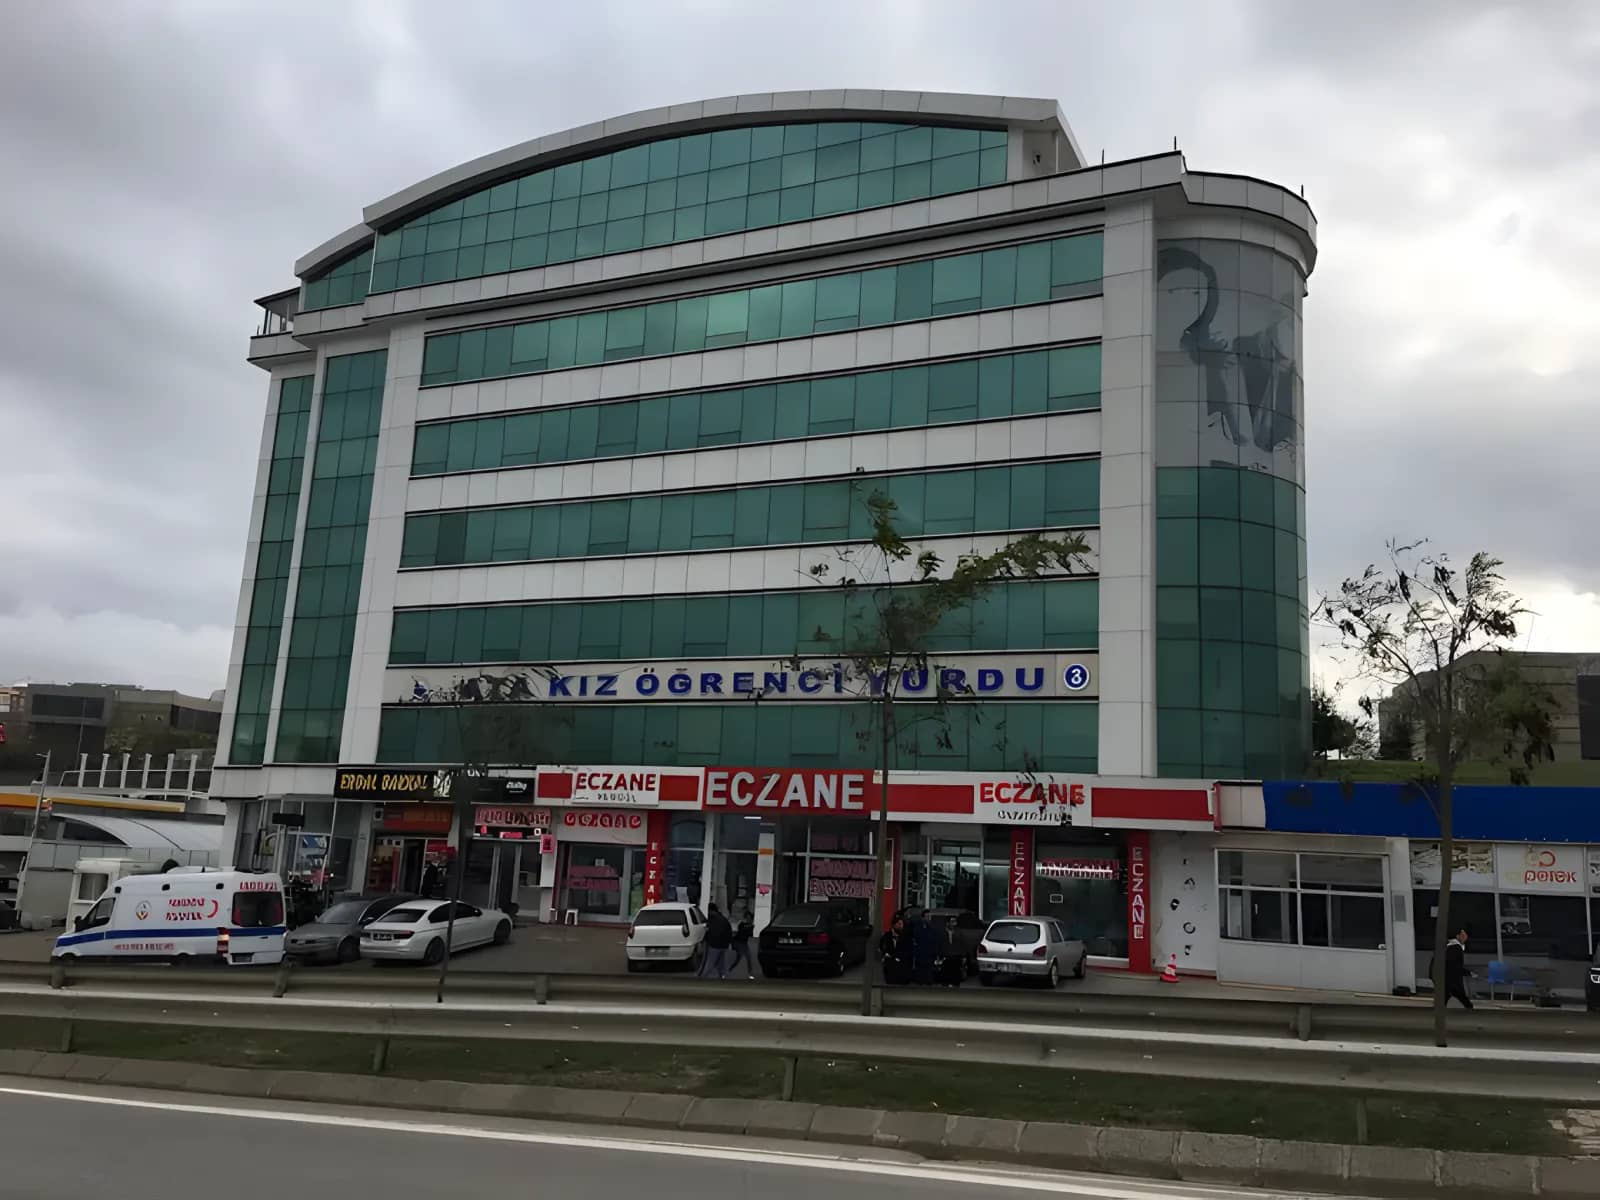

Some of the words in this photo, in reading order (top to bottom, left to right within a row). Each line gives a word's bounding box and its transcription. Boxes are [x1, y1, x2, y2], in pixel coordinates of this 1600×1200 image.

[549, 674, 618, 697] KIZ
[635, 662, 843, 695] ÖĞRENCİ
[575, 772, 657, 792] ECZANE
[705, 771, 865, 810] ECZANE
[979, 782, 1086, 805] ECZANE
[646, 842, 658, 905] ECZAN
[1013, 841, 1026, 916] ECZAN
[1131, 846, 1146, 940] ECZANE
